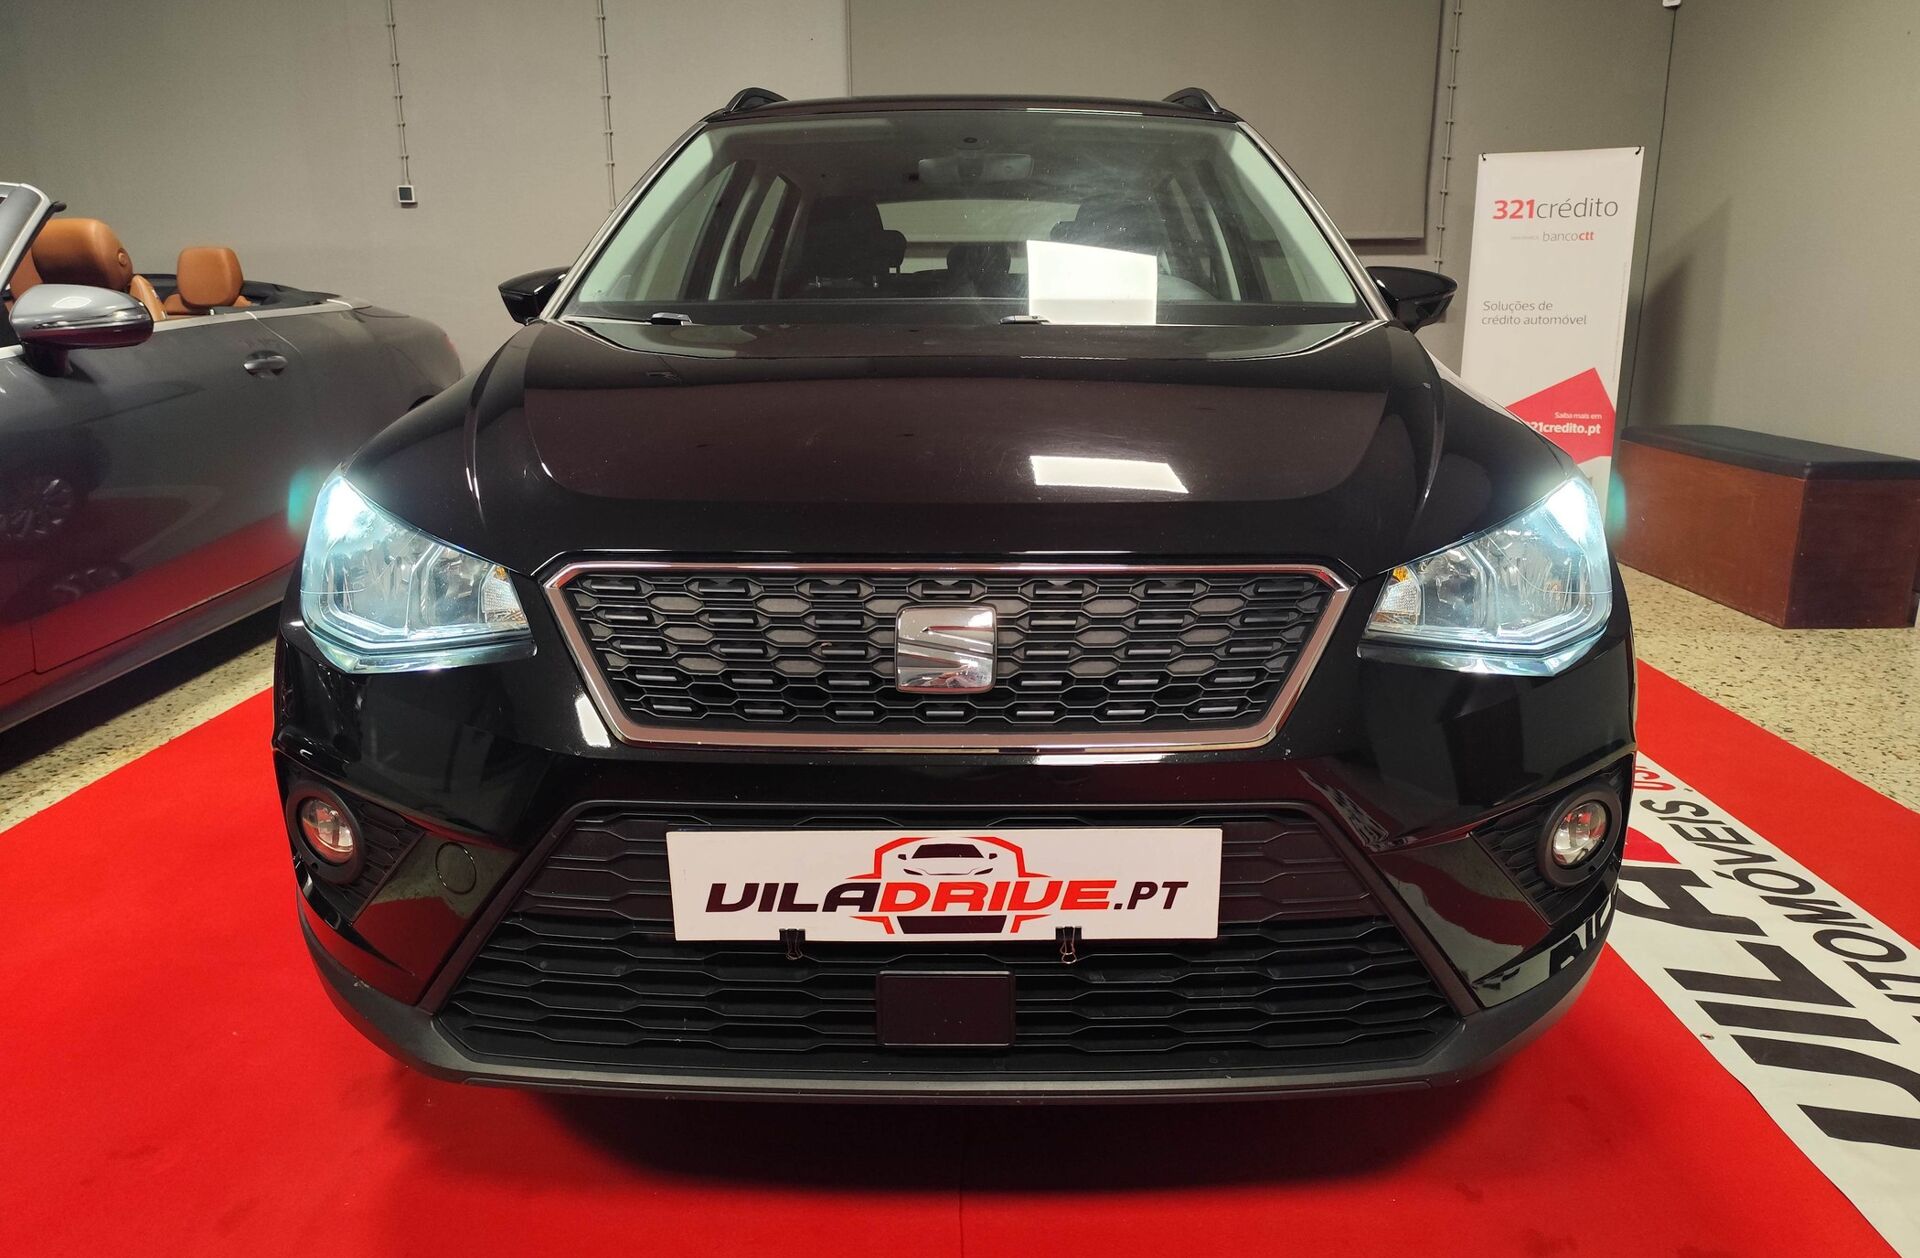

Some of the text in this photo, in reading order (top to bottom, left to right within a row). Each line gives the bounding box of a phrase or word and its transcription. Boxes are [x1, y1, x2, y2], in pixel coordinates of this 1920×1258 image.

[1492, 197, 1619, 220] 321crédito
[1542, 231, 1595, 242] bancoctt
[1483, 300, 1553, 314] Soluções de
[1481, 315, 1587, 326] crédito automóvel
[704, 880, 1189, 913] VILADRIVE.PT
